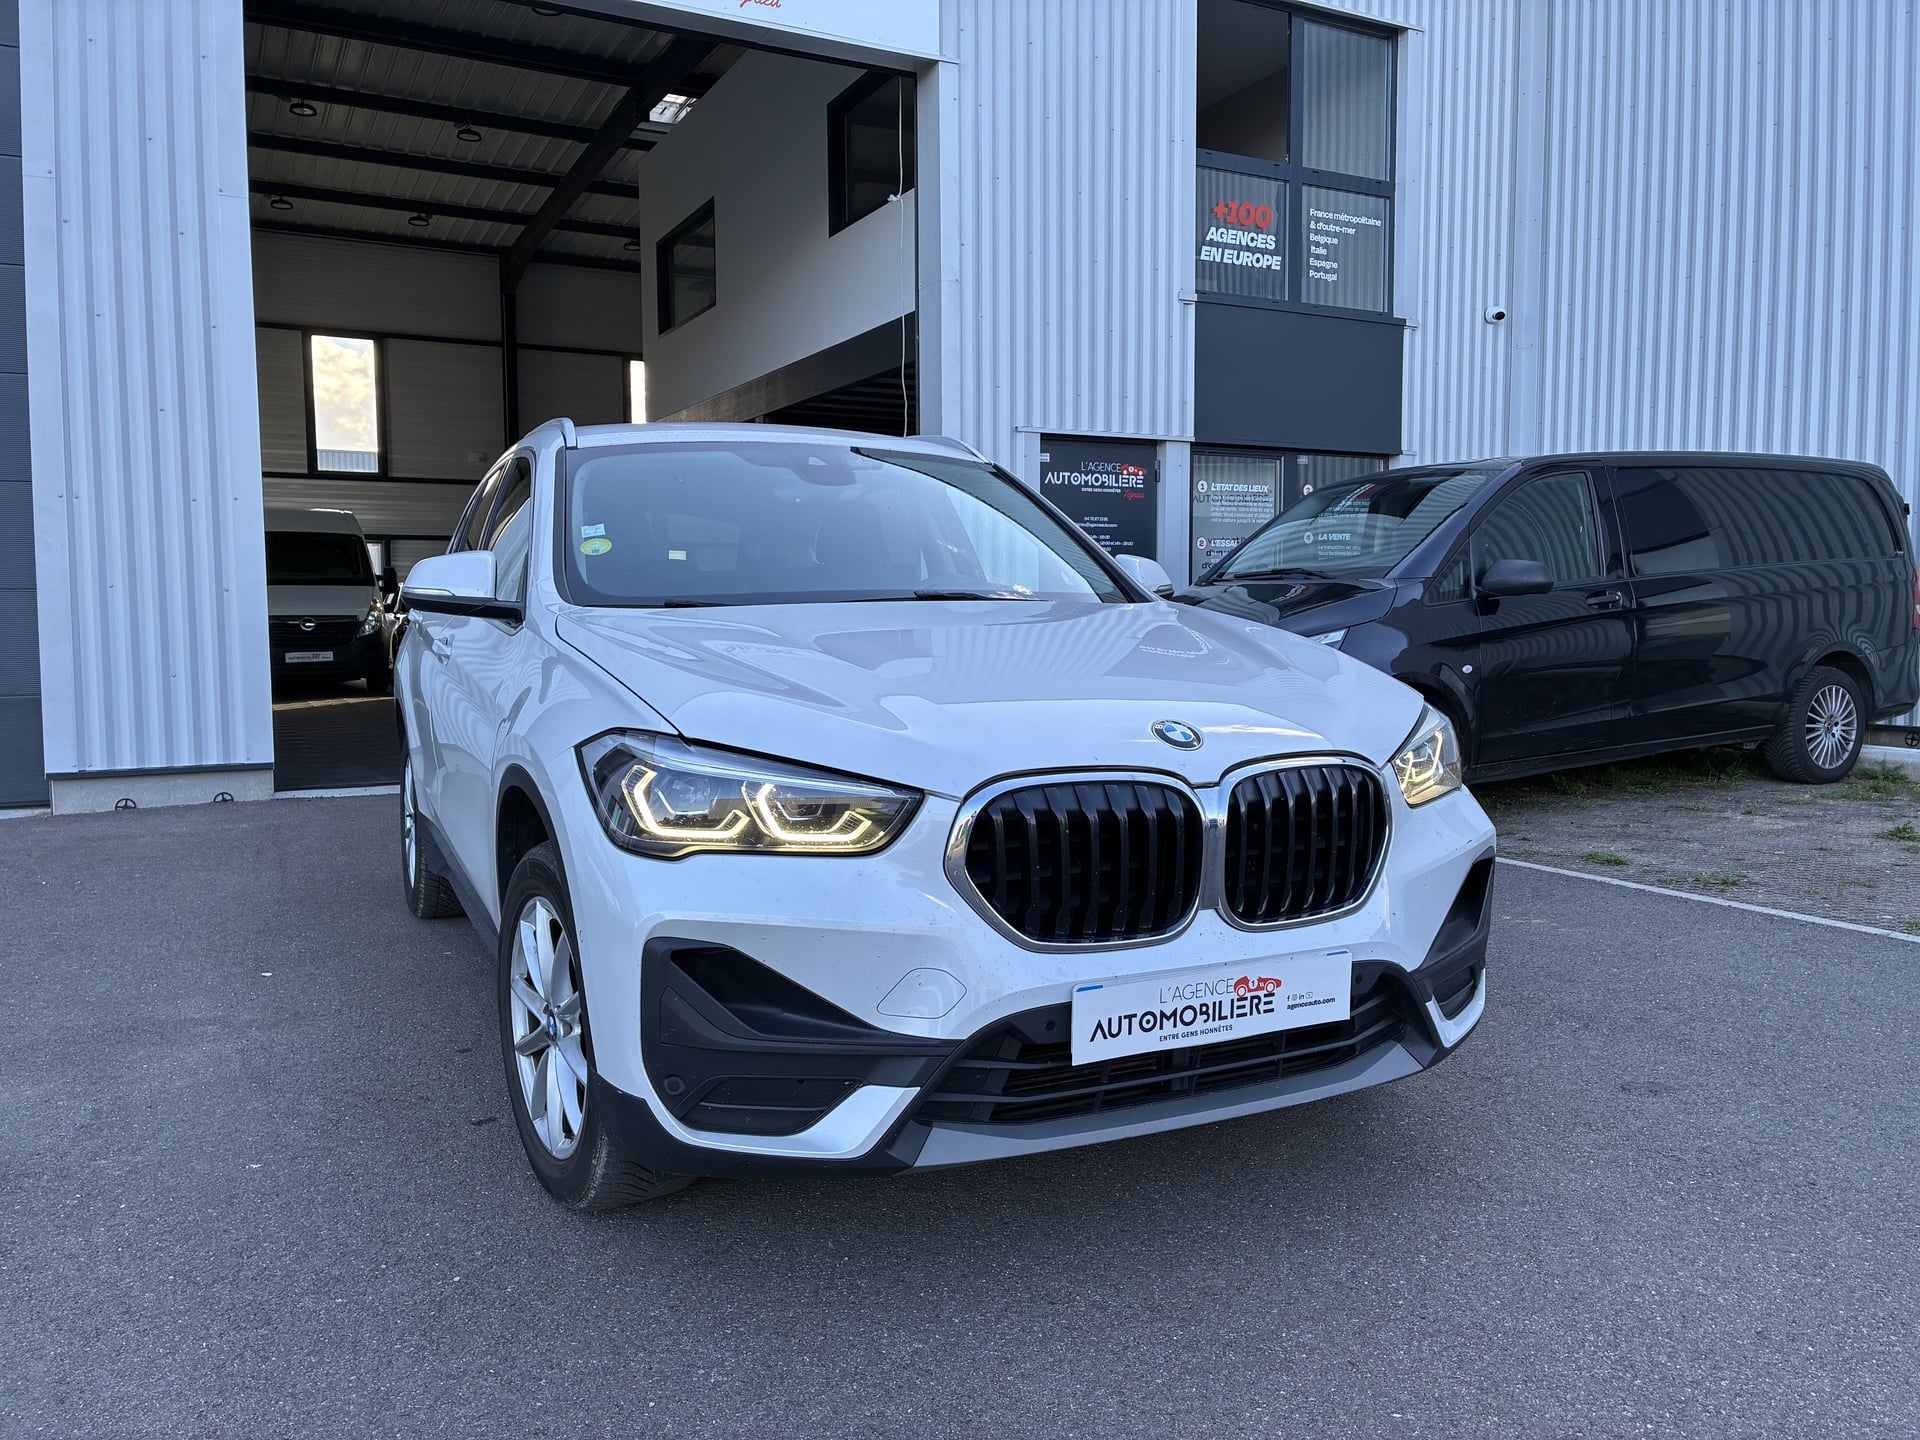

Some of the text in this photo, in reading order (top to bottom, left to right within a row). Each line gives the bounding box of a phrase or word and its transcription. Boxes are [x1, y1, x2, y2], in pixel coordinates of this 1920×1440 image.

[1212, 201, 1273, 229] +100
[1309, 208, 1382, 227] France métropolitaine
[1309, 221, 1356, 235] & d'outre-mer
[1205, 226, 1277, 250] AGENCES
[1309, 233, 1339, 245] Belgique
[1310, 245, 1328, 256] Italie
[1200, 245, 1282, 271] EN EUROPE
[1309, 257, 1339, 270] Espagne
[1309, 270, 1338, 281] Portugal
[1081, 461, 1121, 473] L'AGENCE
[1233, 484, 1248, 492] DES
[1248, 484, 1269, 493] LIEUX
[1318, 533, 1328, 541] LA
[1328, 533, 1351, 541] VENTE
[1159, 977, 1235, 1004] L'AGENCE
[1286, 997, 1336, 1011] agenceauto.com
[1159, 1023, 1233, 1042] ENTRE GENS HONNÊTES
